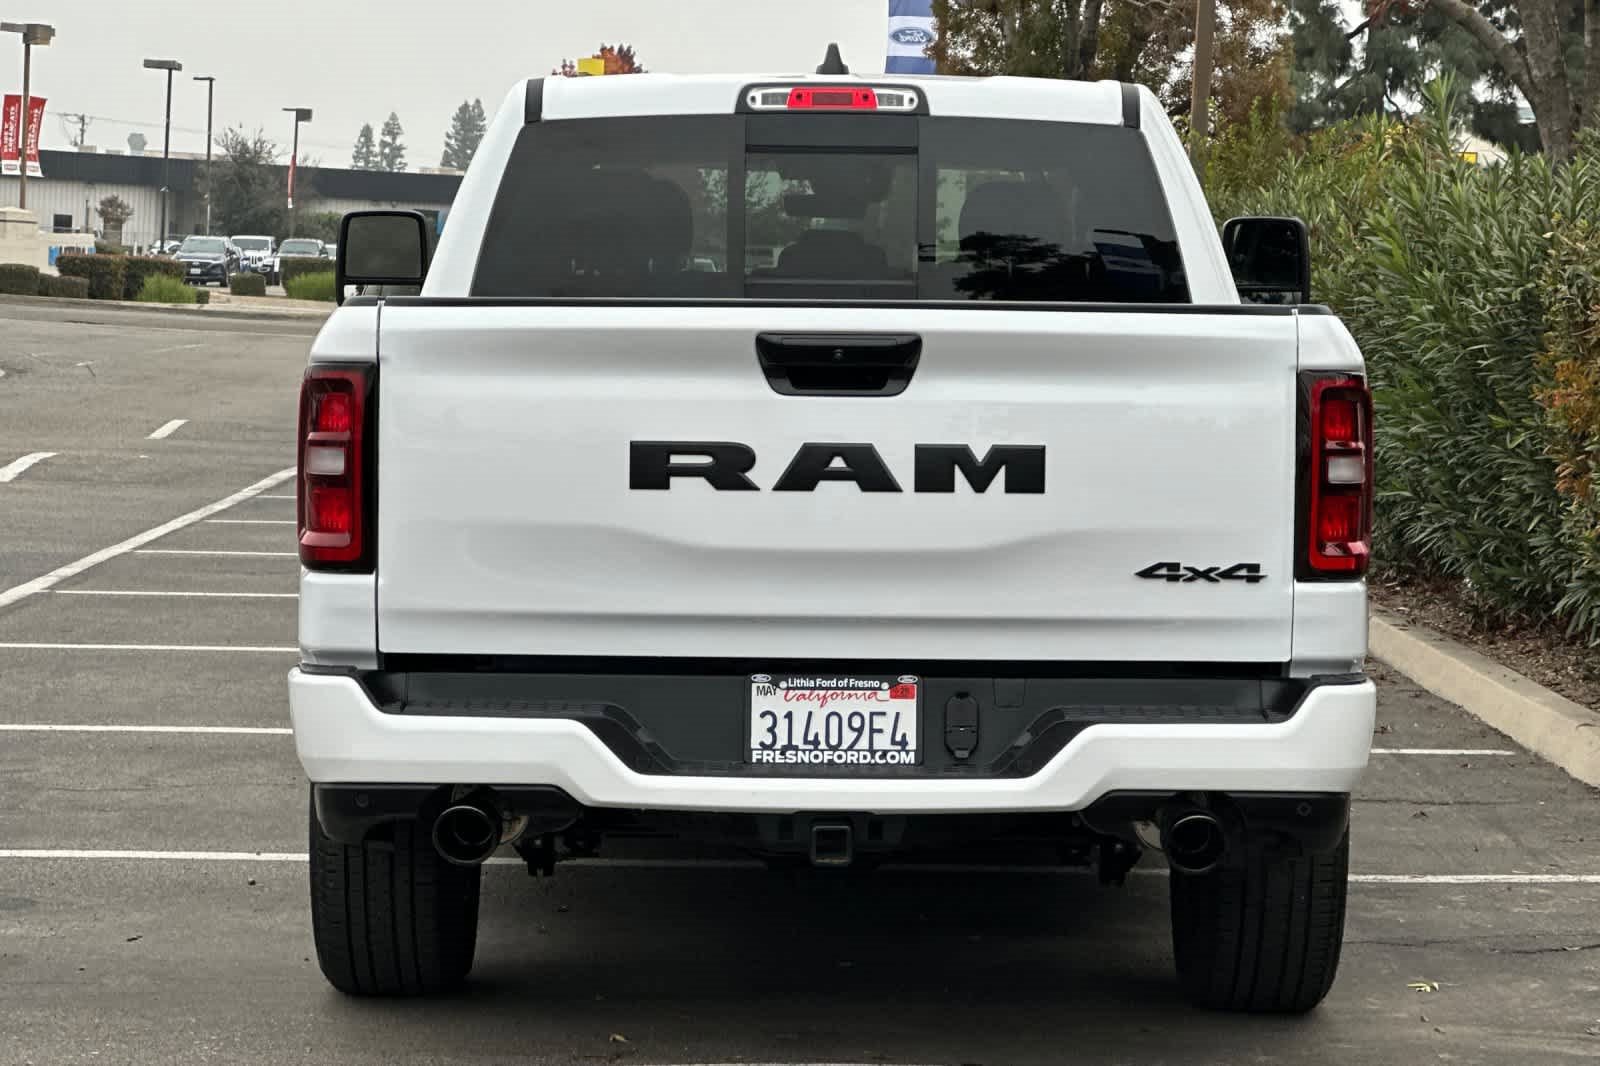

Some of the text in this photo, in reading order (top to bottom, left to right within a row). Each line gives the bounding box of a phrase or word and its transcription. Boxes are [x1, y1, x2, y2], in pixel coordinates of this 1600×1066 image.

[629, 440, 1046, 495] RAM
[1134, 561, 1268, 583] 4x4
[756, 685, 777, 696] MAY
[788, 678, 880, 688] Lithia Ford of Fresno
[759, 710, 909, 750] 31409F4
[752, 751, 915, 764] FRESNOFORD.COM
